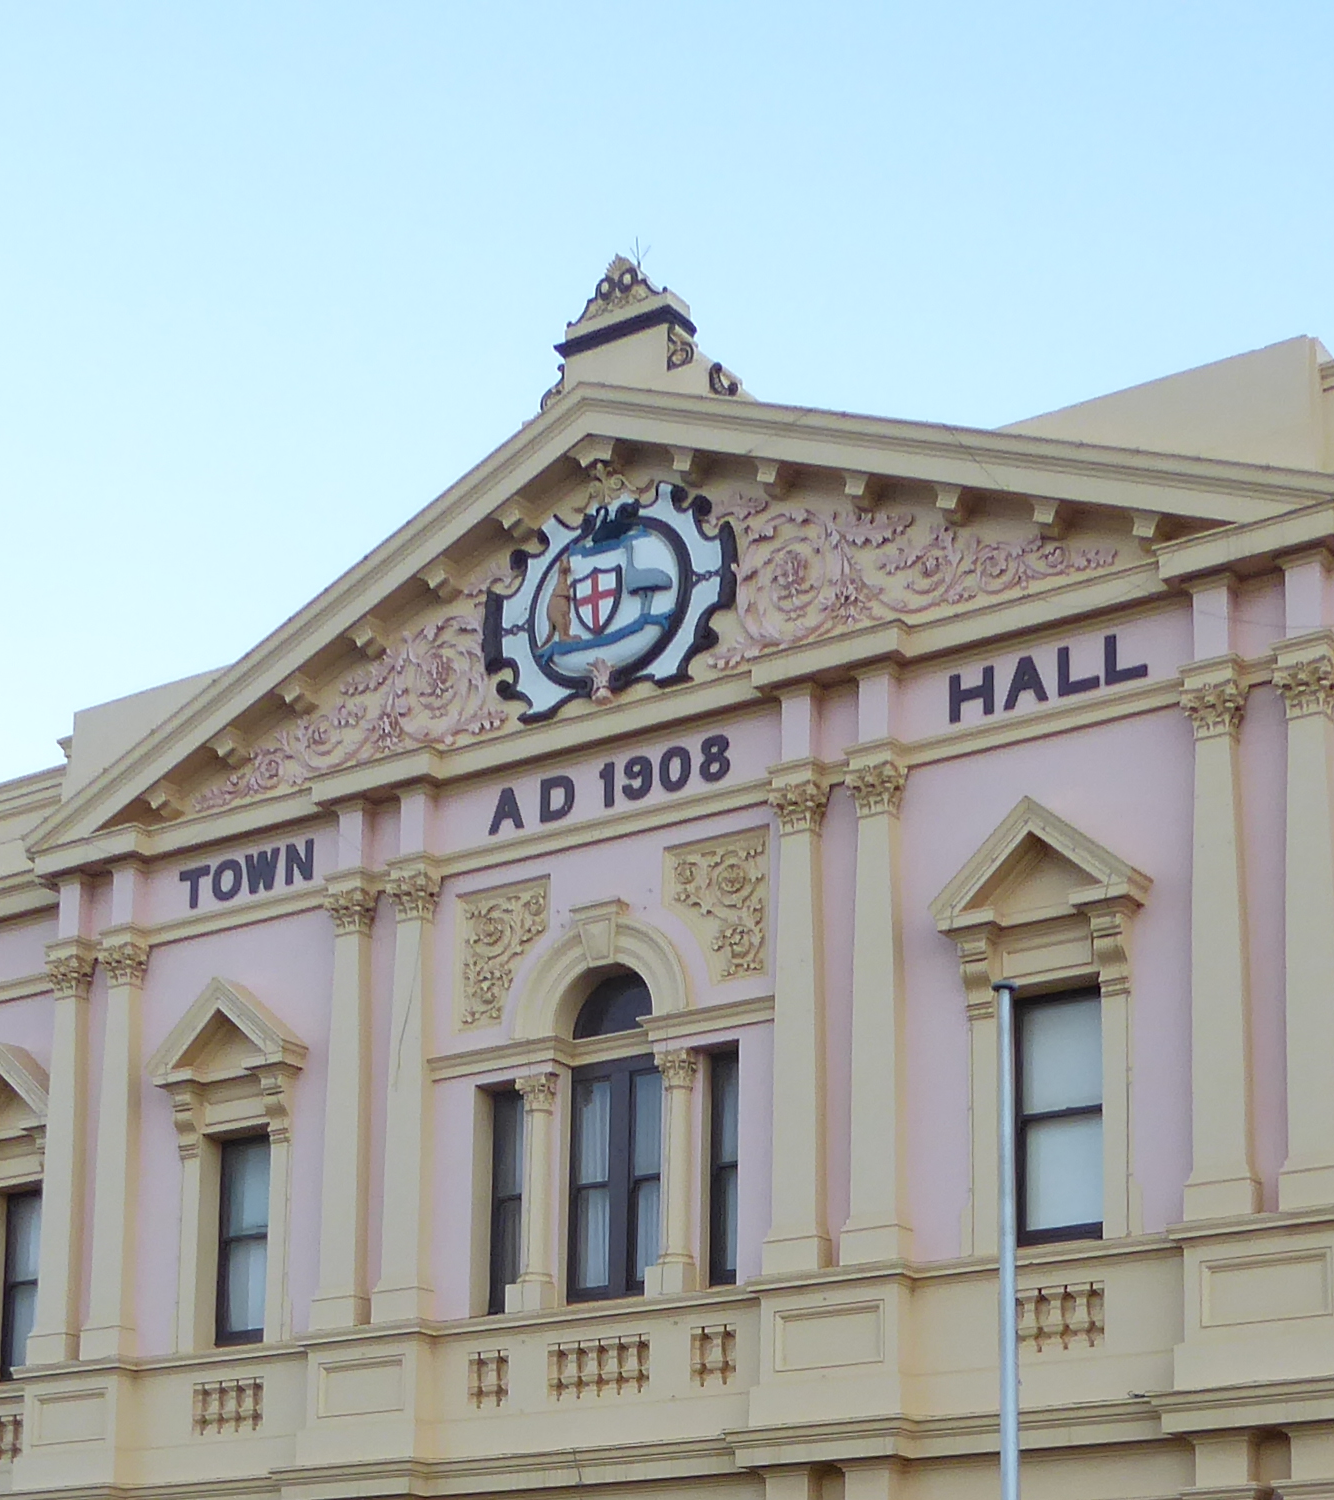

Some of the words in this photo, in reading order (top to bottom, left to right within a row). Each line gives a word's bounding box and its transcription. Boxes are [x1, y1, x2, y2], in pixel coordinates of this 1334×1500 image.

[949, 633, 1148, 724] HALL
[488, 775, 575, 836] AD
[599, 734, 731, 809] 1908
[179, 838, 315, 909] TOWN
